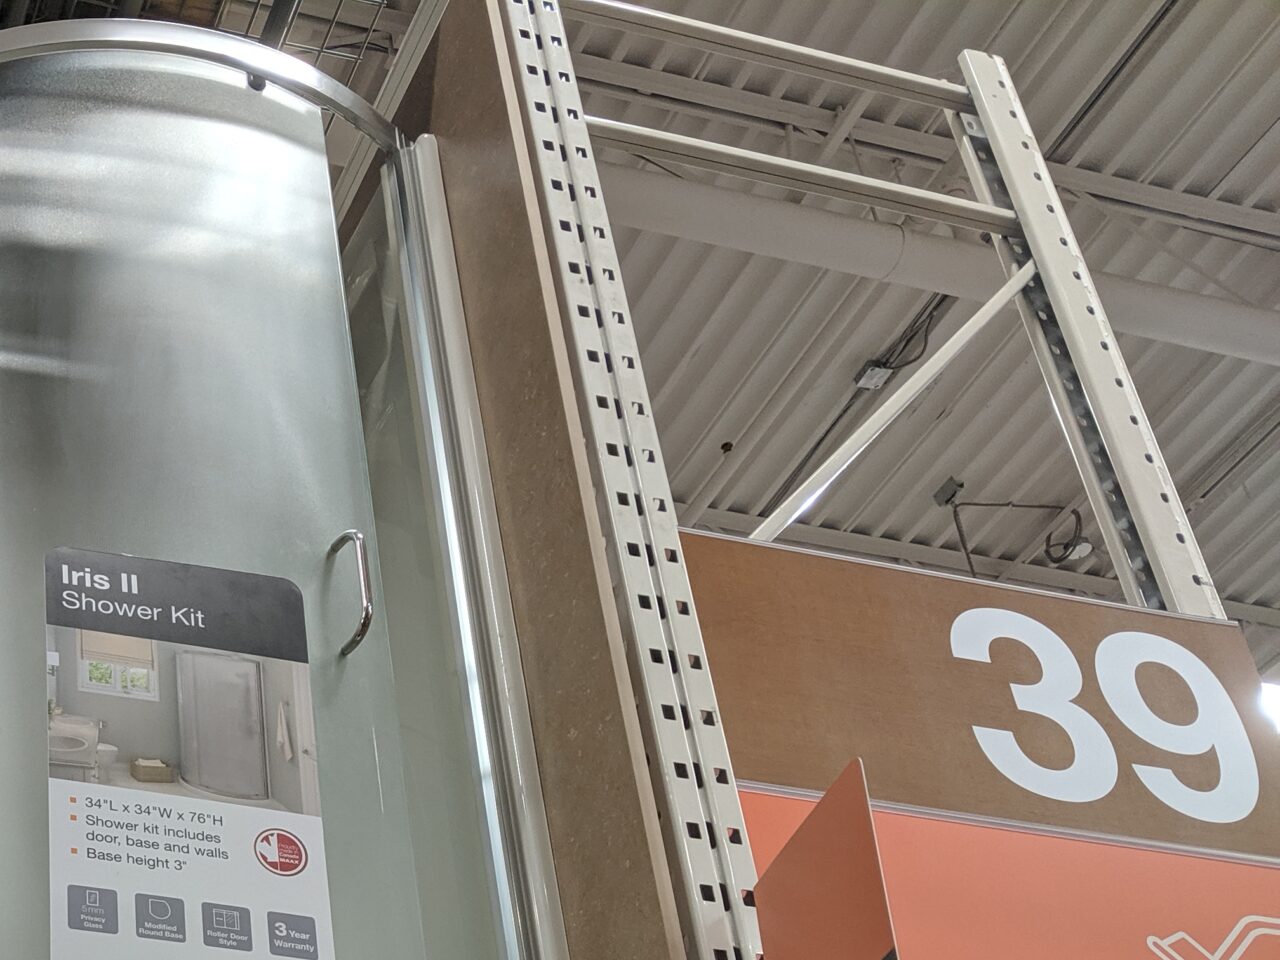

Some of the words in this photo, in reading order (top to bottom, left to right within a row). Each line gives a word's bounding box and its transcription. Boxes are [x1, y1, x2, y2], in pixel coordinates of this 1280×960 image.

[62, 564, 110, 590] Iris
[121, 573, 138, 594] II
[62, 590, 162, 621] Shower
[171, 606, 205, 628] Kit
[950, 607, 1260, 824] 39
[85, 797, 118, 811] 34"L
[122, 804, 130, 813] x
[134, 804, 172, 819] 34"W
[177, 812, 185, 821] x
[188, 812, 223, 826] 76"H
[85, 814, 139, 832] Shower
[143, 822, 159, 835] kit
[164, 825, 221, 843] includes
[86, 831, 121, 846] door,
[126, 835, 160, 849] base
[164, 842, 189, 854] and
[194, 846, 229, 859] walls
[86, 847, 122, 862] Base
[126, 853, 170, 870] height
[174, 859, 187, 870] 3"
[81, 914, 106, 924] Privacy
[84, 921, 103, 929] Glass
[144, 921, 177, 932] Modified
[139, 928, 163, 937] Round
[165, 931, 183, 940] Base
[207, 930, 229, 939] Roller
[230, 933, 248, 942] Door
[274, 922, 287, 936] 3
[289, 930, 310, 941] Year
[219, 938, 237, 947] Style
[274, 939, 315, 953] Warranty
